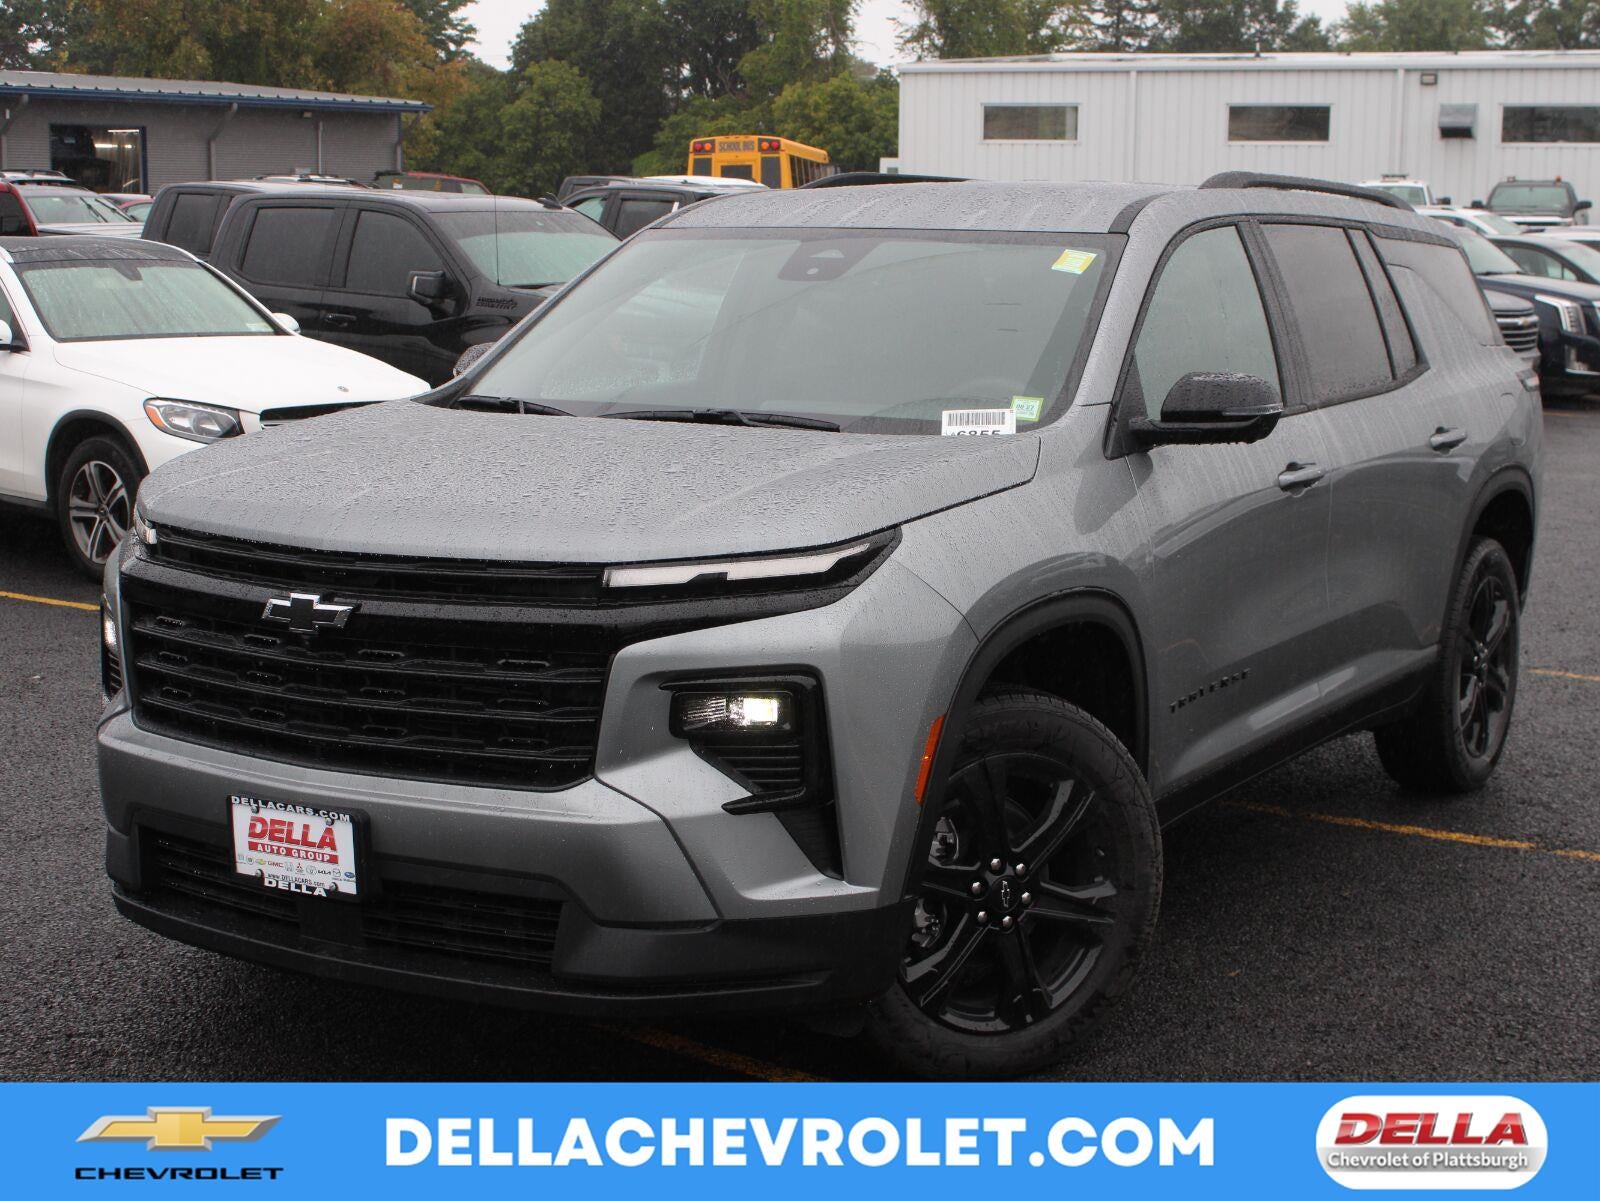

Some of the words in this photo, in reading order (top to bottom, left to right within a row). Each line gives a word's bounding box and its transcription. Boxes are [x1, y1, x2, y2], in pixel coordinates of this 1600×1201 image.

[231, 796, 350, 822] DELLACARS.COM
[248, 816, 338, 852] DELLA
[257, 843, 287, 855] AUTO
[291, 849, 331, 862] GROUP
[264, 878, 328, 897] DELLA
